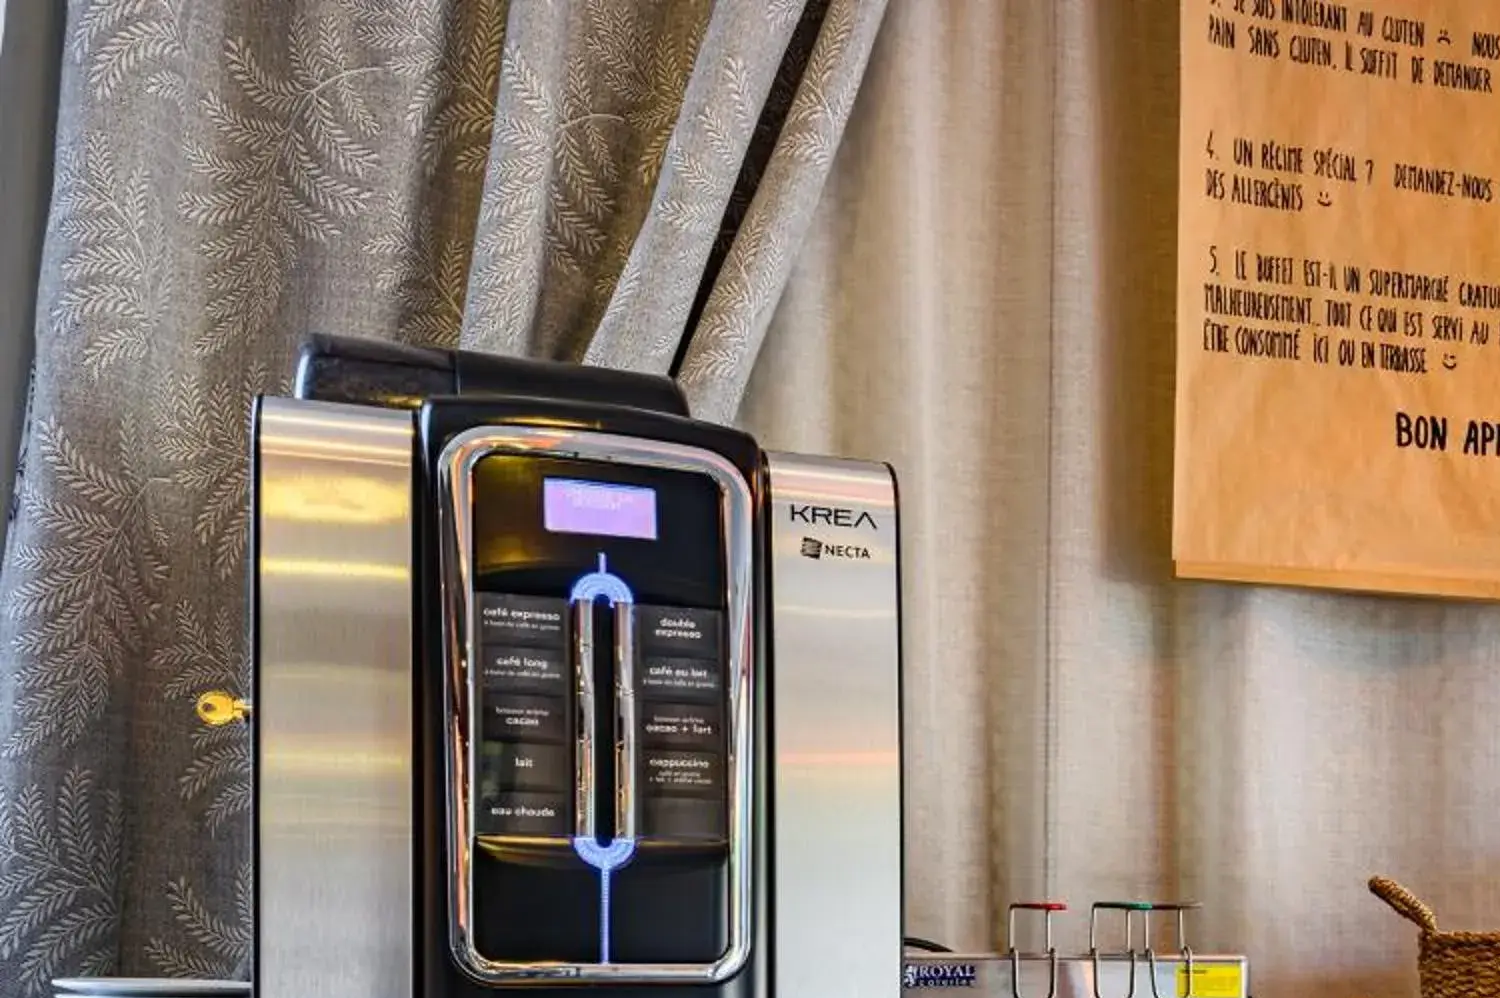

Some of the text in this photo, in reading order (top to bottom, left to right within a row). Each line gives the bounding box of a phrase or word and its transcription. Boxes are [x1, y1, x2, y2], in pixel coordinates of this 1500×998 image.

[1208, 14, 1236, 49] PAIN
[1248, 25, 1280, 59] SANS
[1360, 47, 1398, 80] SUFFIT
[1411, 56, 1425, 84] DE
[1434, 60, 1493, 93] DEMANDER
[1356, 11, 1374, 37] AU
[1381, 16, 1425, 48] GLUTEN
[1472, 32, 1500, 60] NOUS
[1206, 130, 1220, 161] 4.
[1233, 137, 1253, 168] UN
[1393, 163, 1493, 203] DEMANDEZ-NOUS
[1206, 168, 1225, 200] DES
[1209, 245, 1221, 277] 5.
[1235, 249, 1248, 281] LE
[1256, 253, 1294, 285] BUFFET
[1343, 265, 1361, 294] UN
[1368, 268, 1449, 303] SUPERMARCHÉ
[1325, 299, 1353, 328] TOUT
[1359, 304, 1373, 332] CE
[1403, 311, 1423, 337] EST
[1470, 320, 1489, 345] AU
[1203, 317, 1230, 353] ÊTRE
[1235, 325, 1301, 361] CONSOMMÉ
[1338, 338, 1356, 367] OU
[1361, 341, 1376, 369] EN
[1380, 342, 1428, 374] TERRASSE
[1396, 411, 1447, 451] BON
[790, 504, 878, 530] KREA
[825, 544, 871, 559] NECTA
[919, 964, 976, 977] ROYAL
